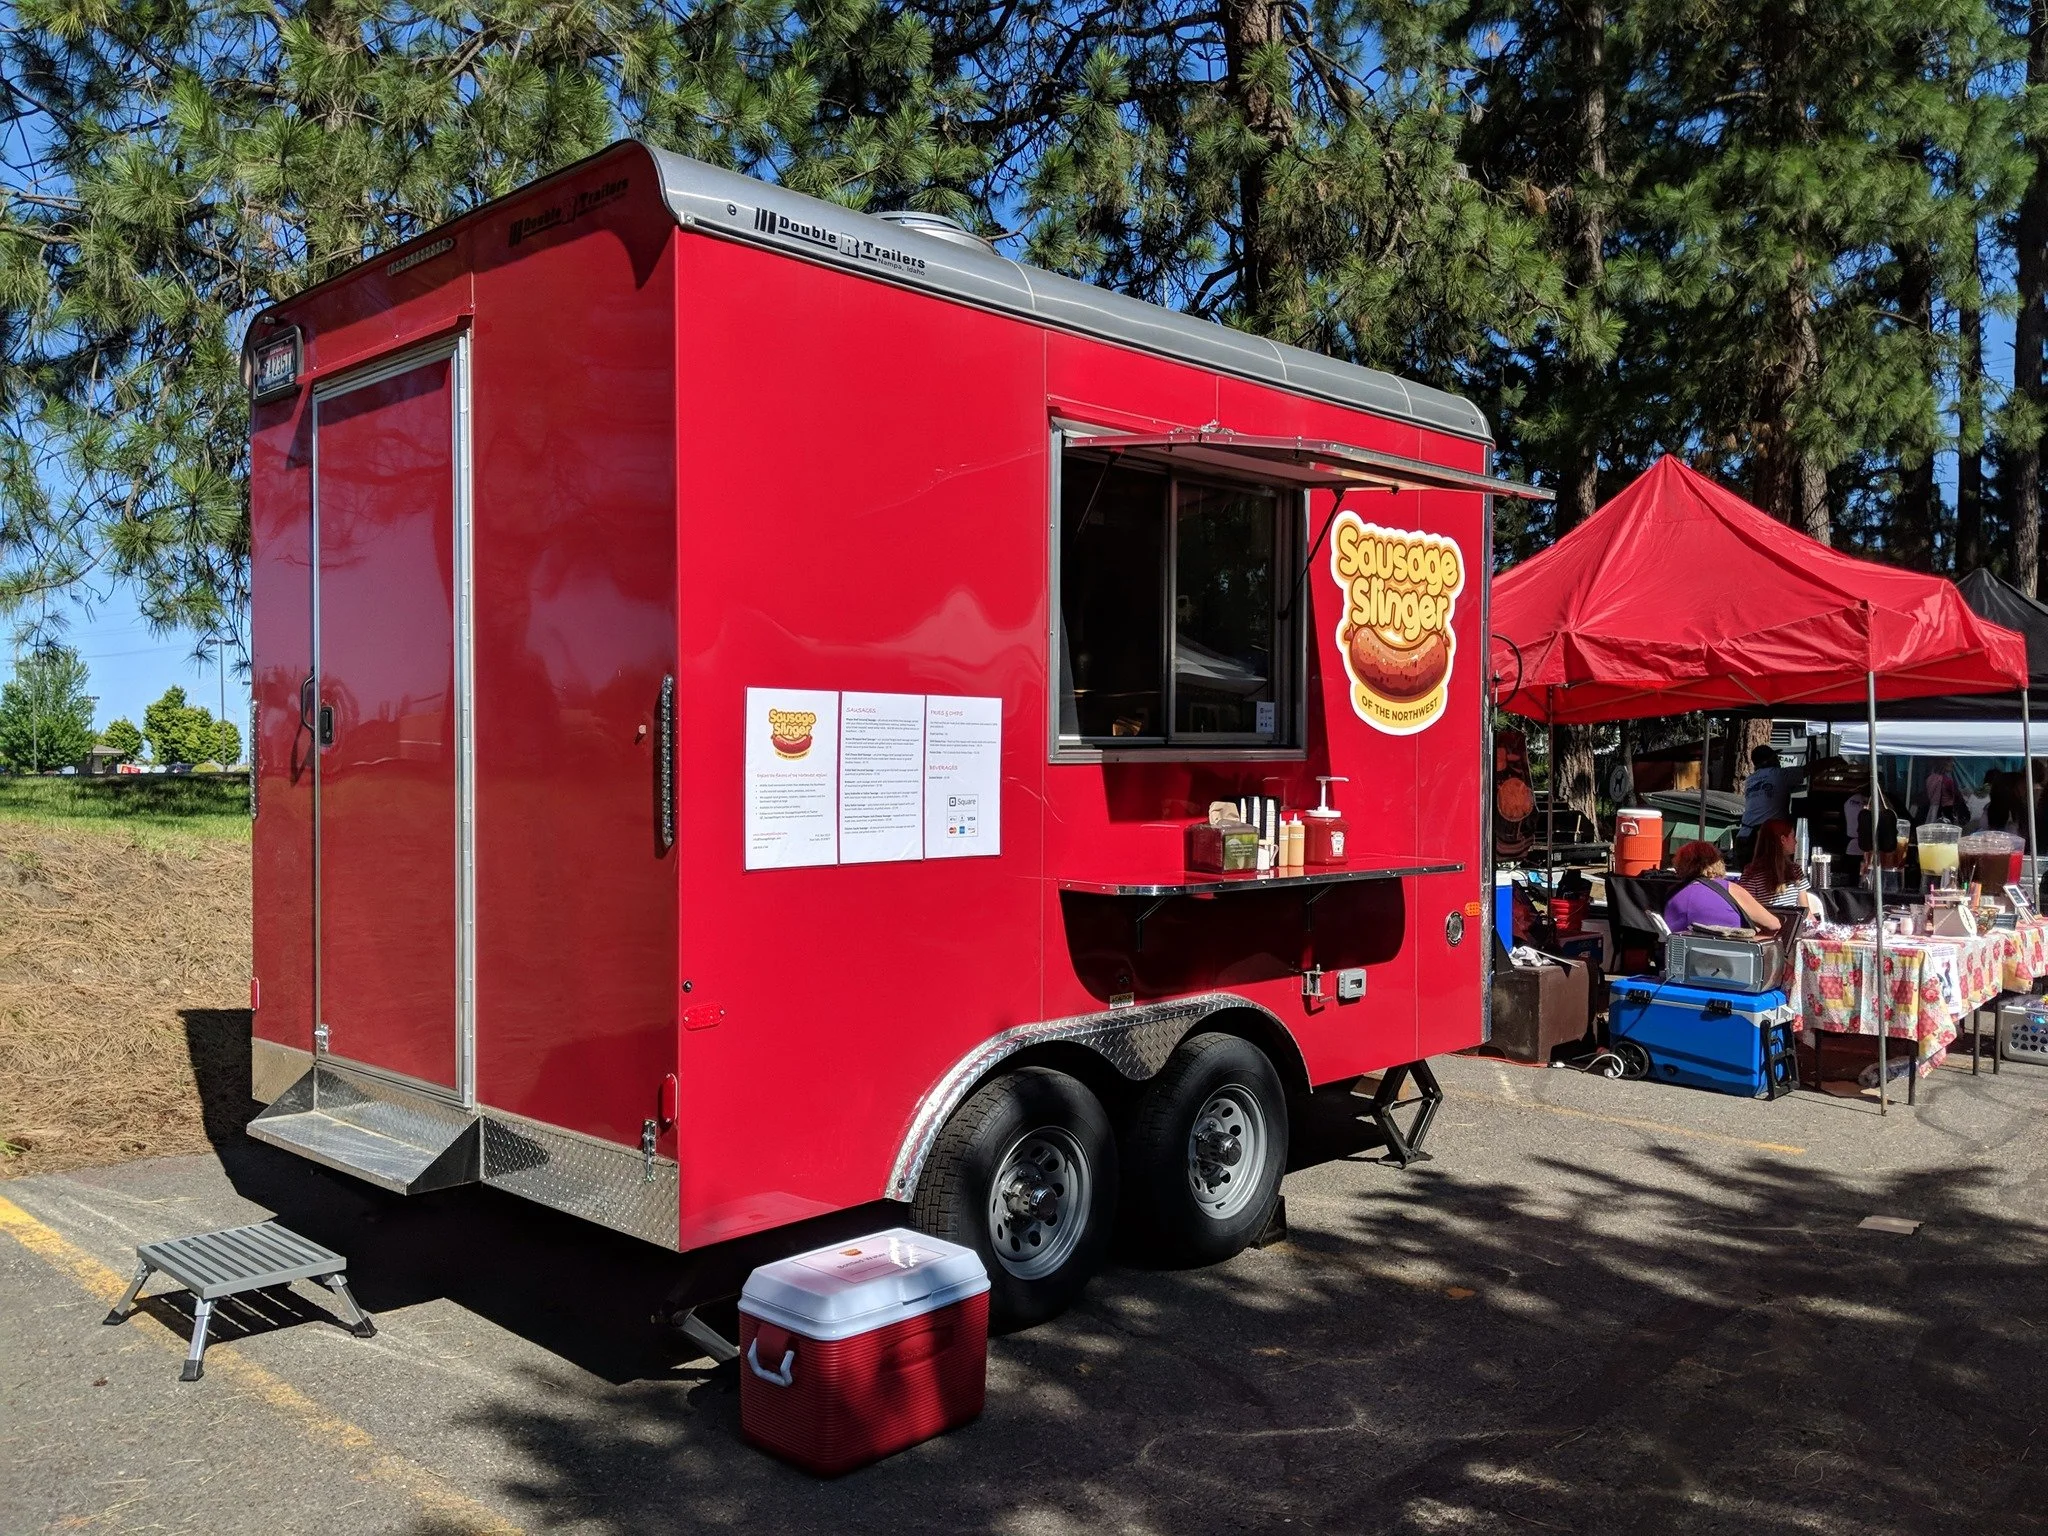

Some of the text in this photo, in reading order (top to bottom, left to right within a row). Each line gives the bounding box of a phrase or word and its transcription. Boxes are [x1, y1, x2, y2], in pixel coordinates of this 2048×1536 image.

[579, 178, 628, 207] Trailers
[779, 215, 836, 244] Double
[863, 241, 926, 269] Trailers
[878, 258, 926, 276] Nampa, Idaho
[1338, 524, 1458, 596] Sausage
[1350, 577, 1449, 641] Slinger
[768, 708, 817, 726] Sausage
[1361, 695, 1438, 721] OF THE NORTHWEST
[773, 722, 813, 738] Slinger
[957, 798, 976, 806] Square
